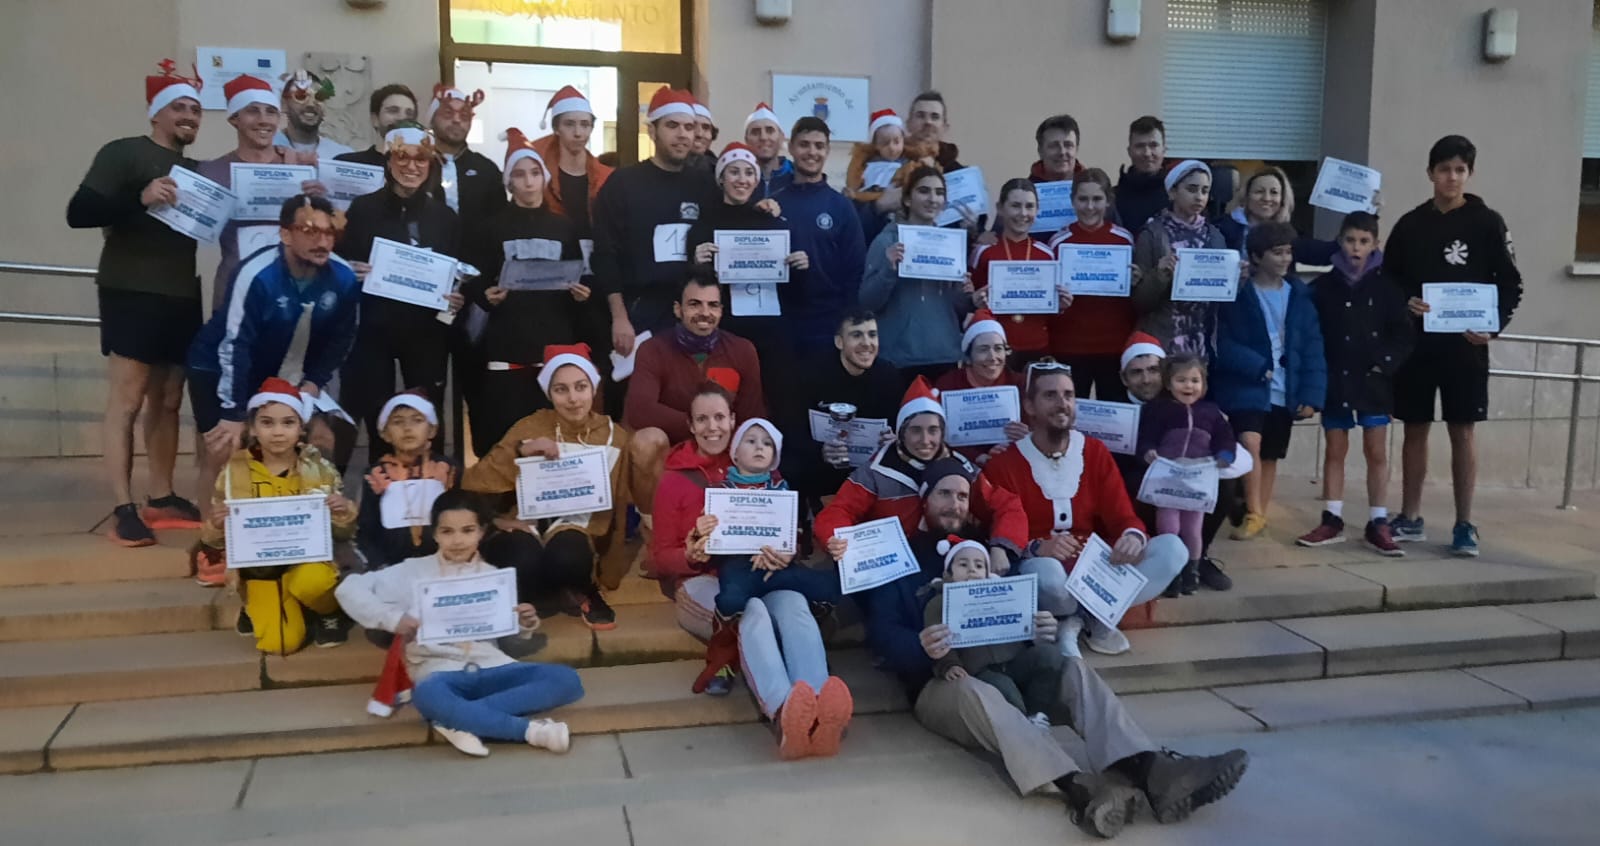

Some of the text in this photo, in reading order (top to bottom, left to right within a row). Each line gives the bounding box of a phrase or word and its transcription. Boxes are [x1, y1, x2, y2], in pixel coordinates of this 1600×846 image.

[788, 82, 845, 104] Ayuntamiento
[539, 458, 584, 470] DIPLOMA
[729, 496, 773, 504] DIPLOMA
[969, 584, 1014, 596] DIPLOMA
